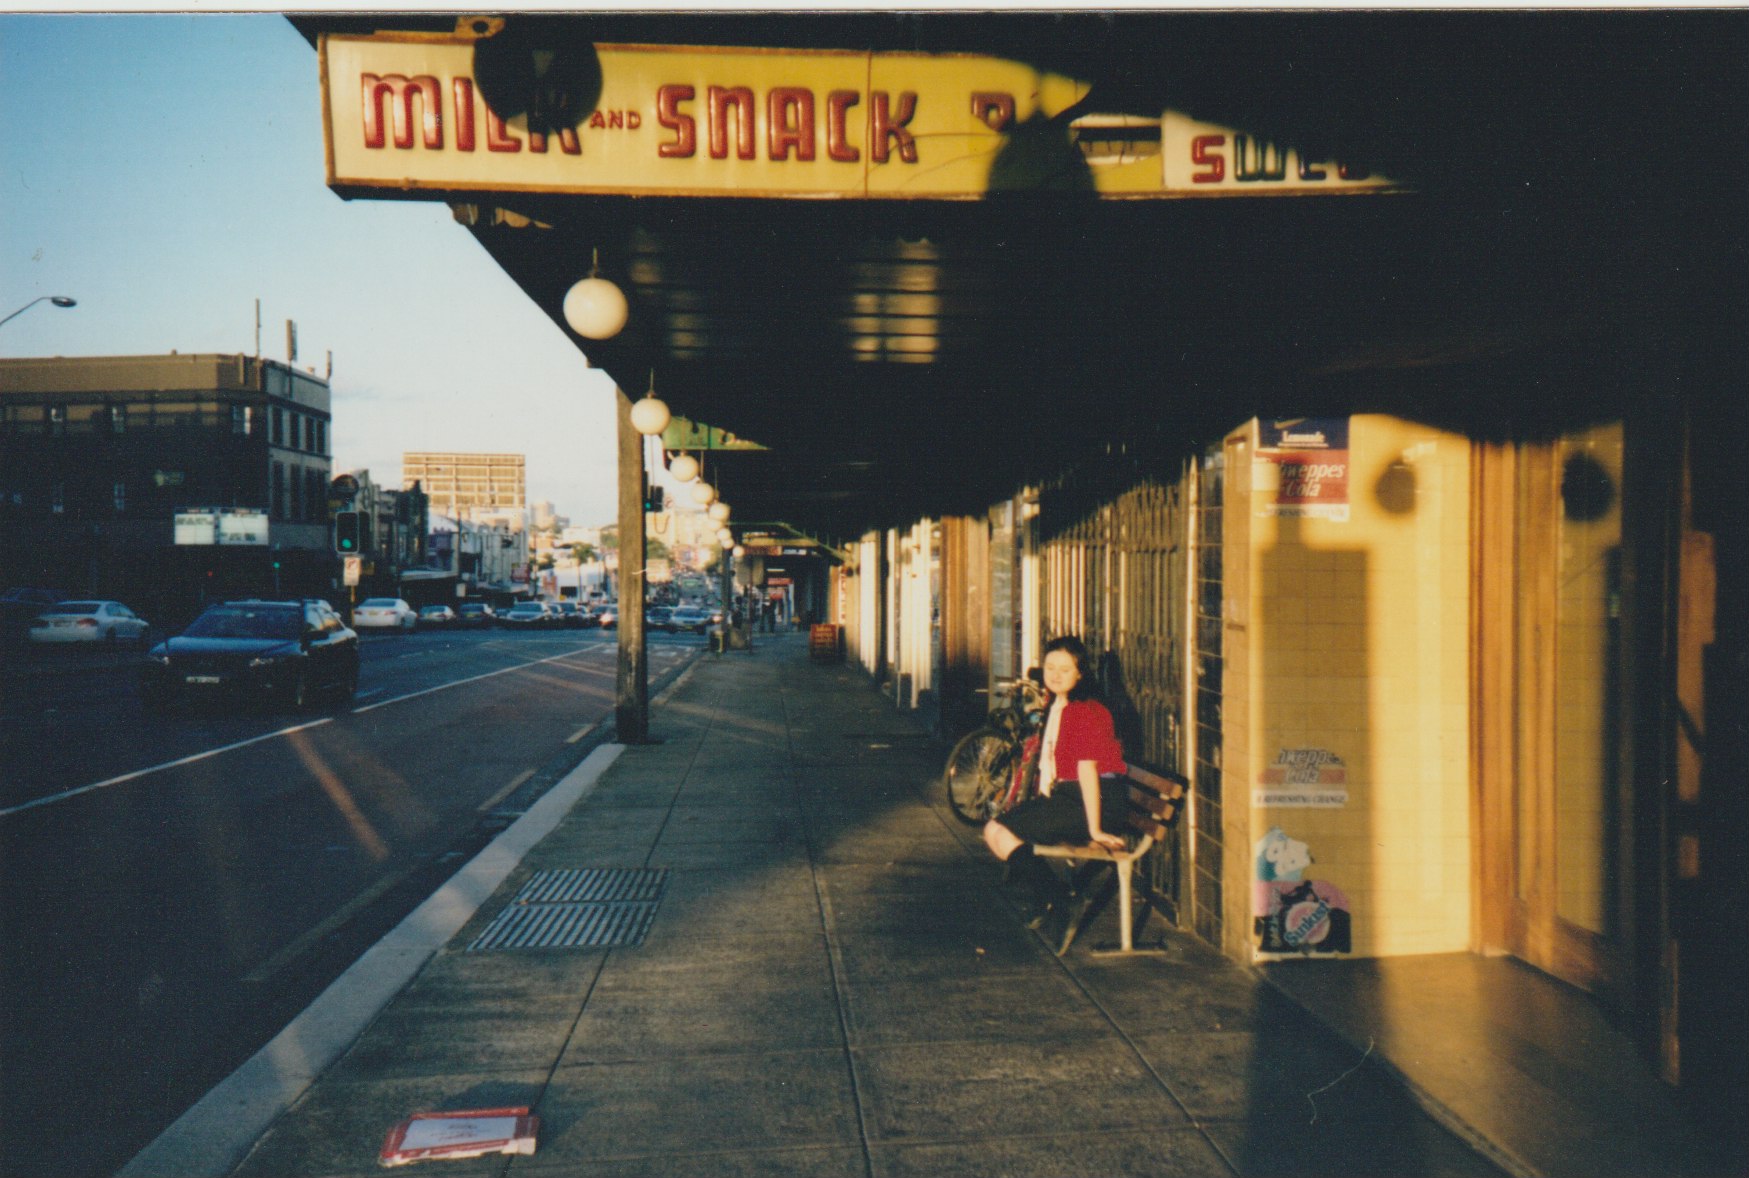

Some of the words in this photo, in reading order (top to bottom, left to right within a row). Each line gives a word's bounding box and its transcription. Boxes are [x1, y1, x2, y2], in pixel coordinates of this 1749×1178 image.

[589, 110, 641, 131] AND
[657, 85, 918, 164] SNACK
[1283, 899, 1331, 947] Sunkist
